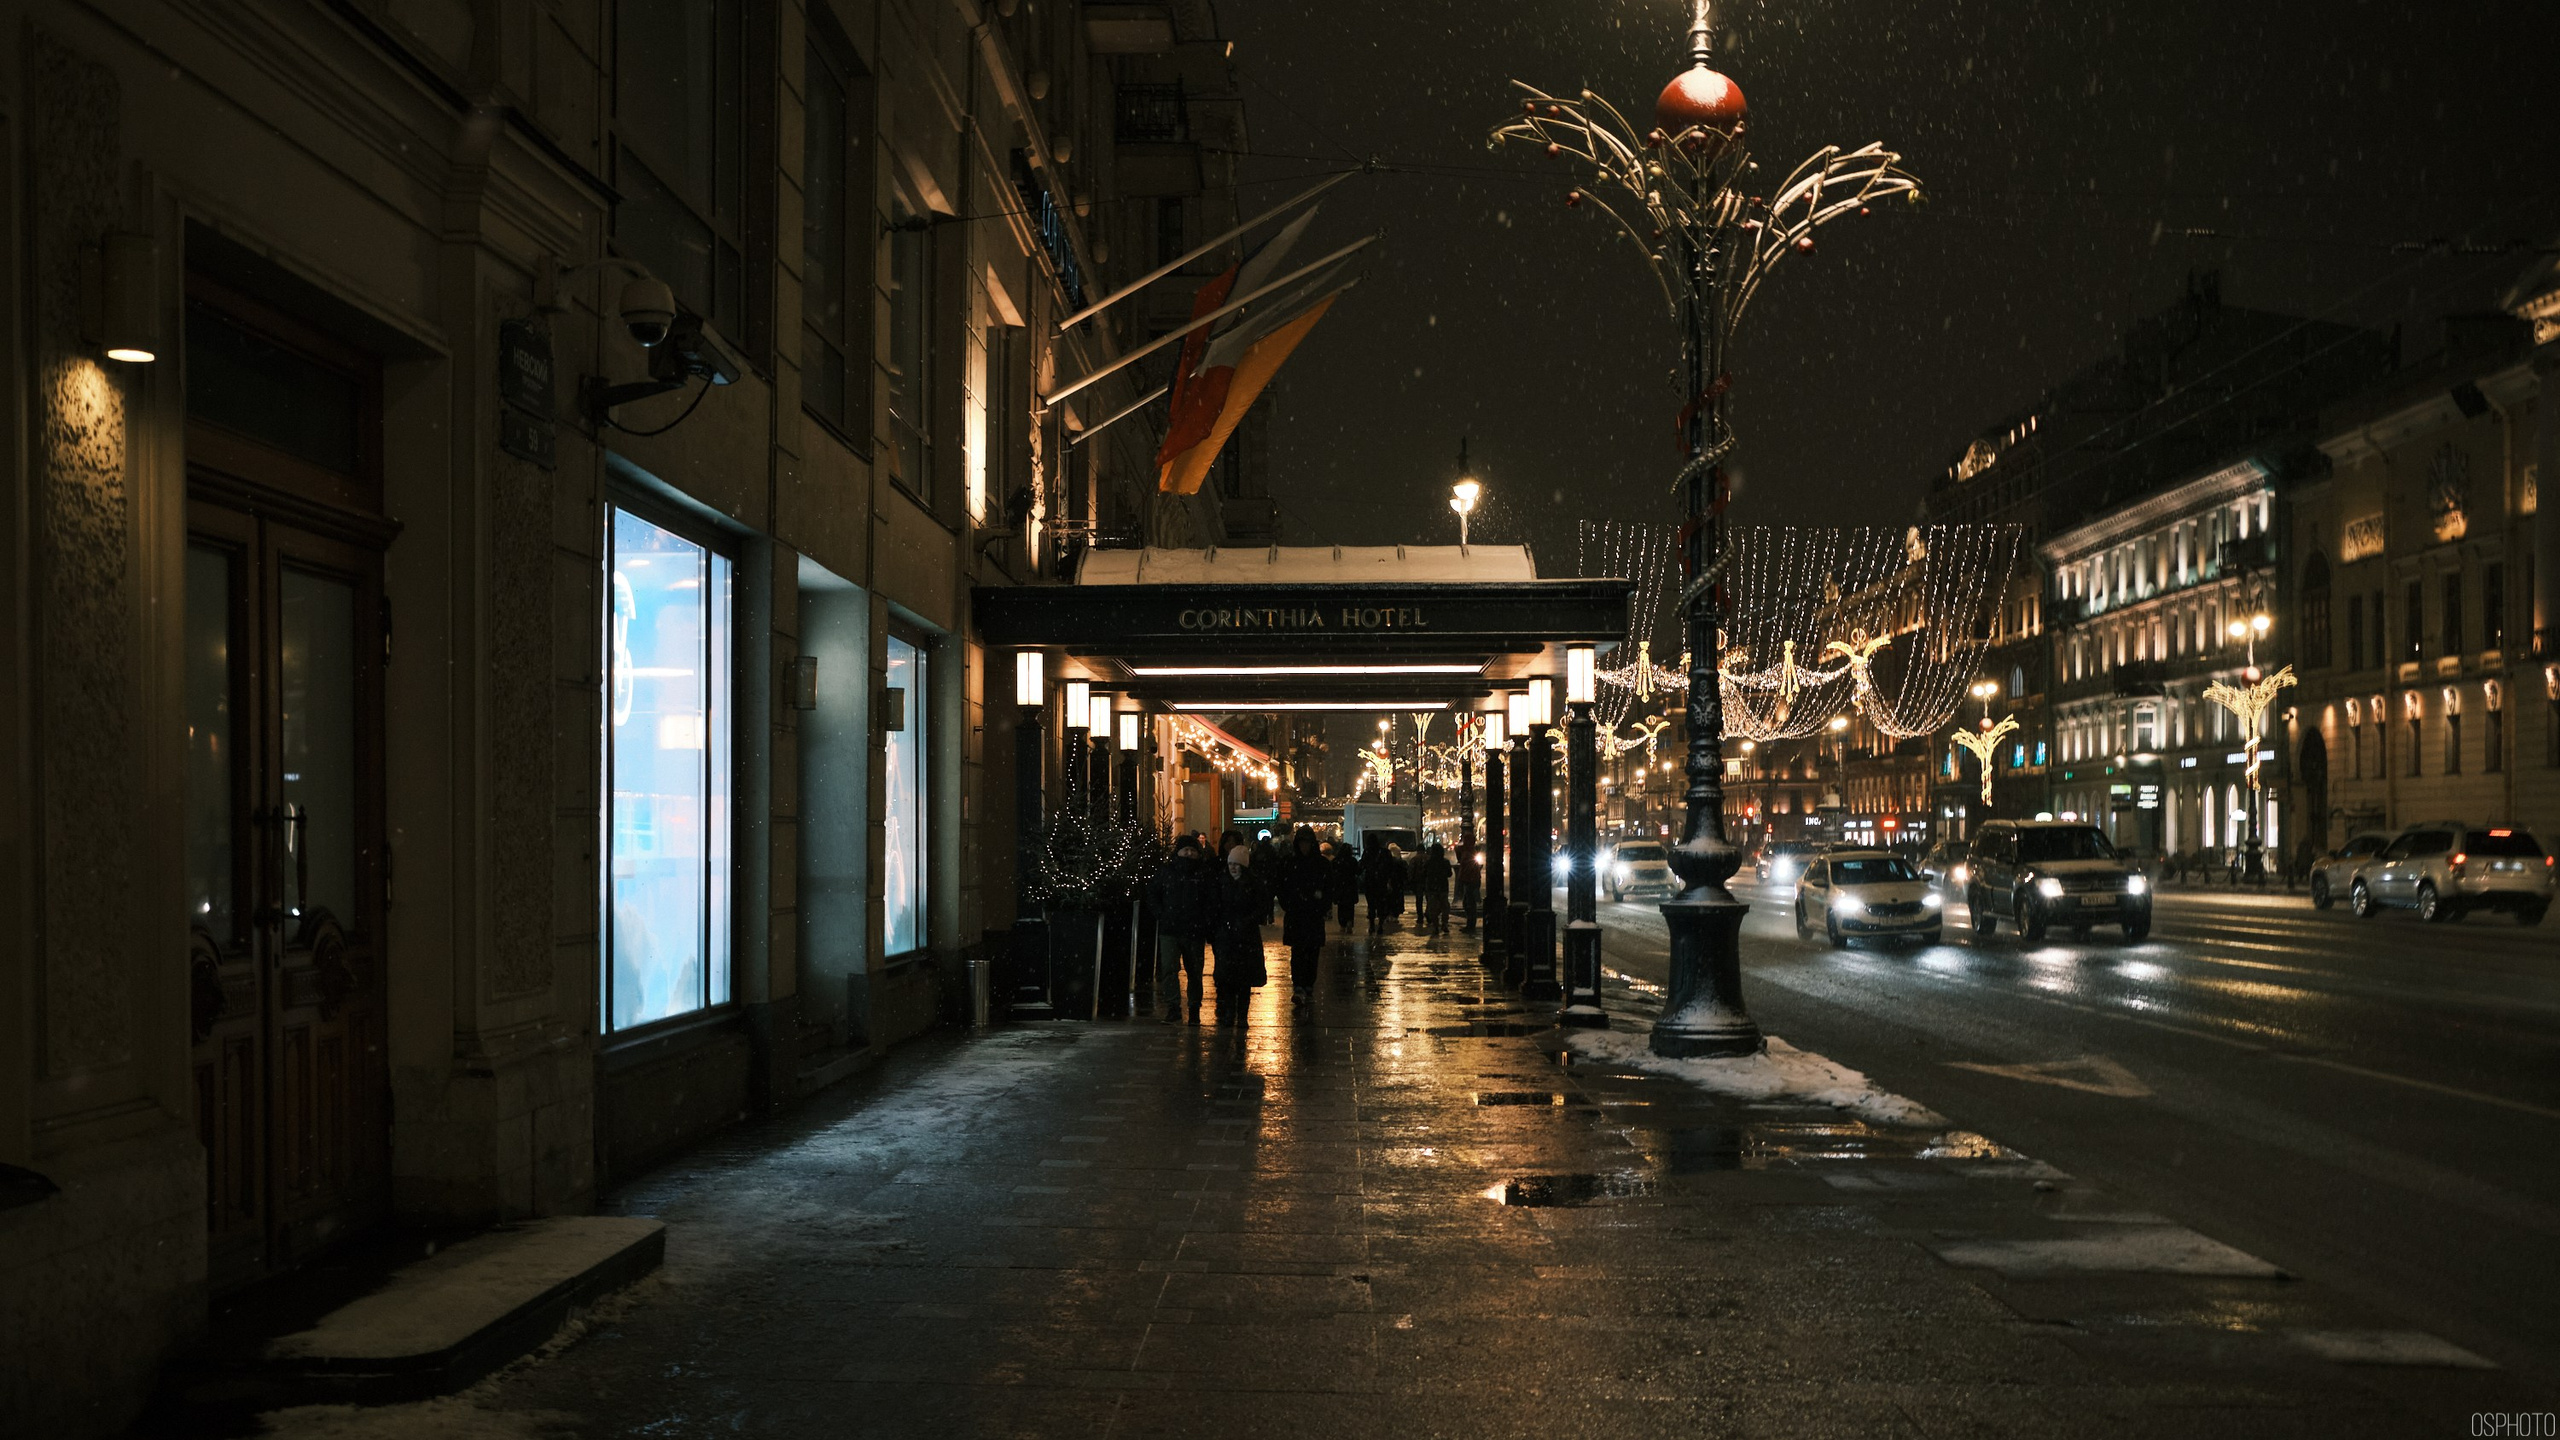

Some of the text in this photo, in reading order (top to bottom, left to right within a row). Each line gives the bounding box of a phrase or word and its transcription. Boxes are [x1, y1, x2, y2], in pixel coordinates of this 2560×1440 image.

[513, 345, 548, 383] НЕВСКИЙ
[1179, 607, 1430, 630] CORINTHIA HOTEL
